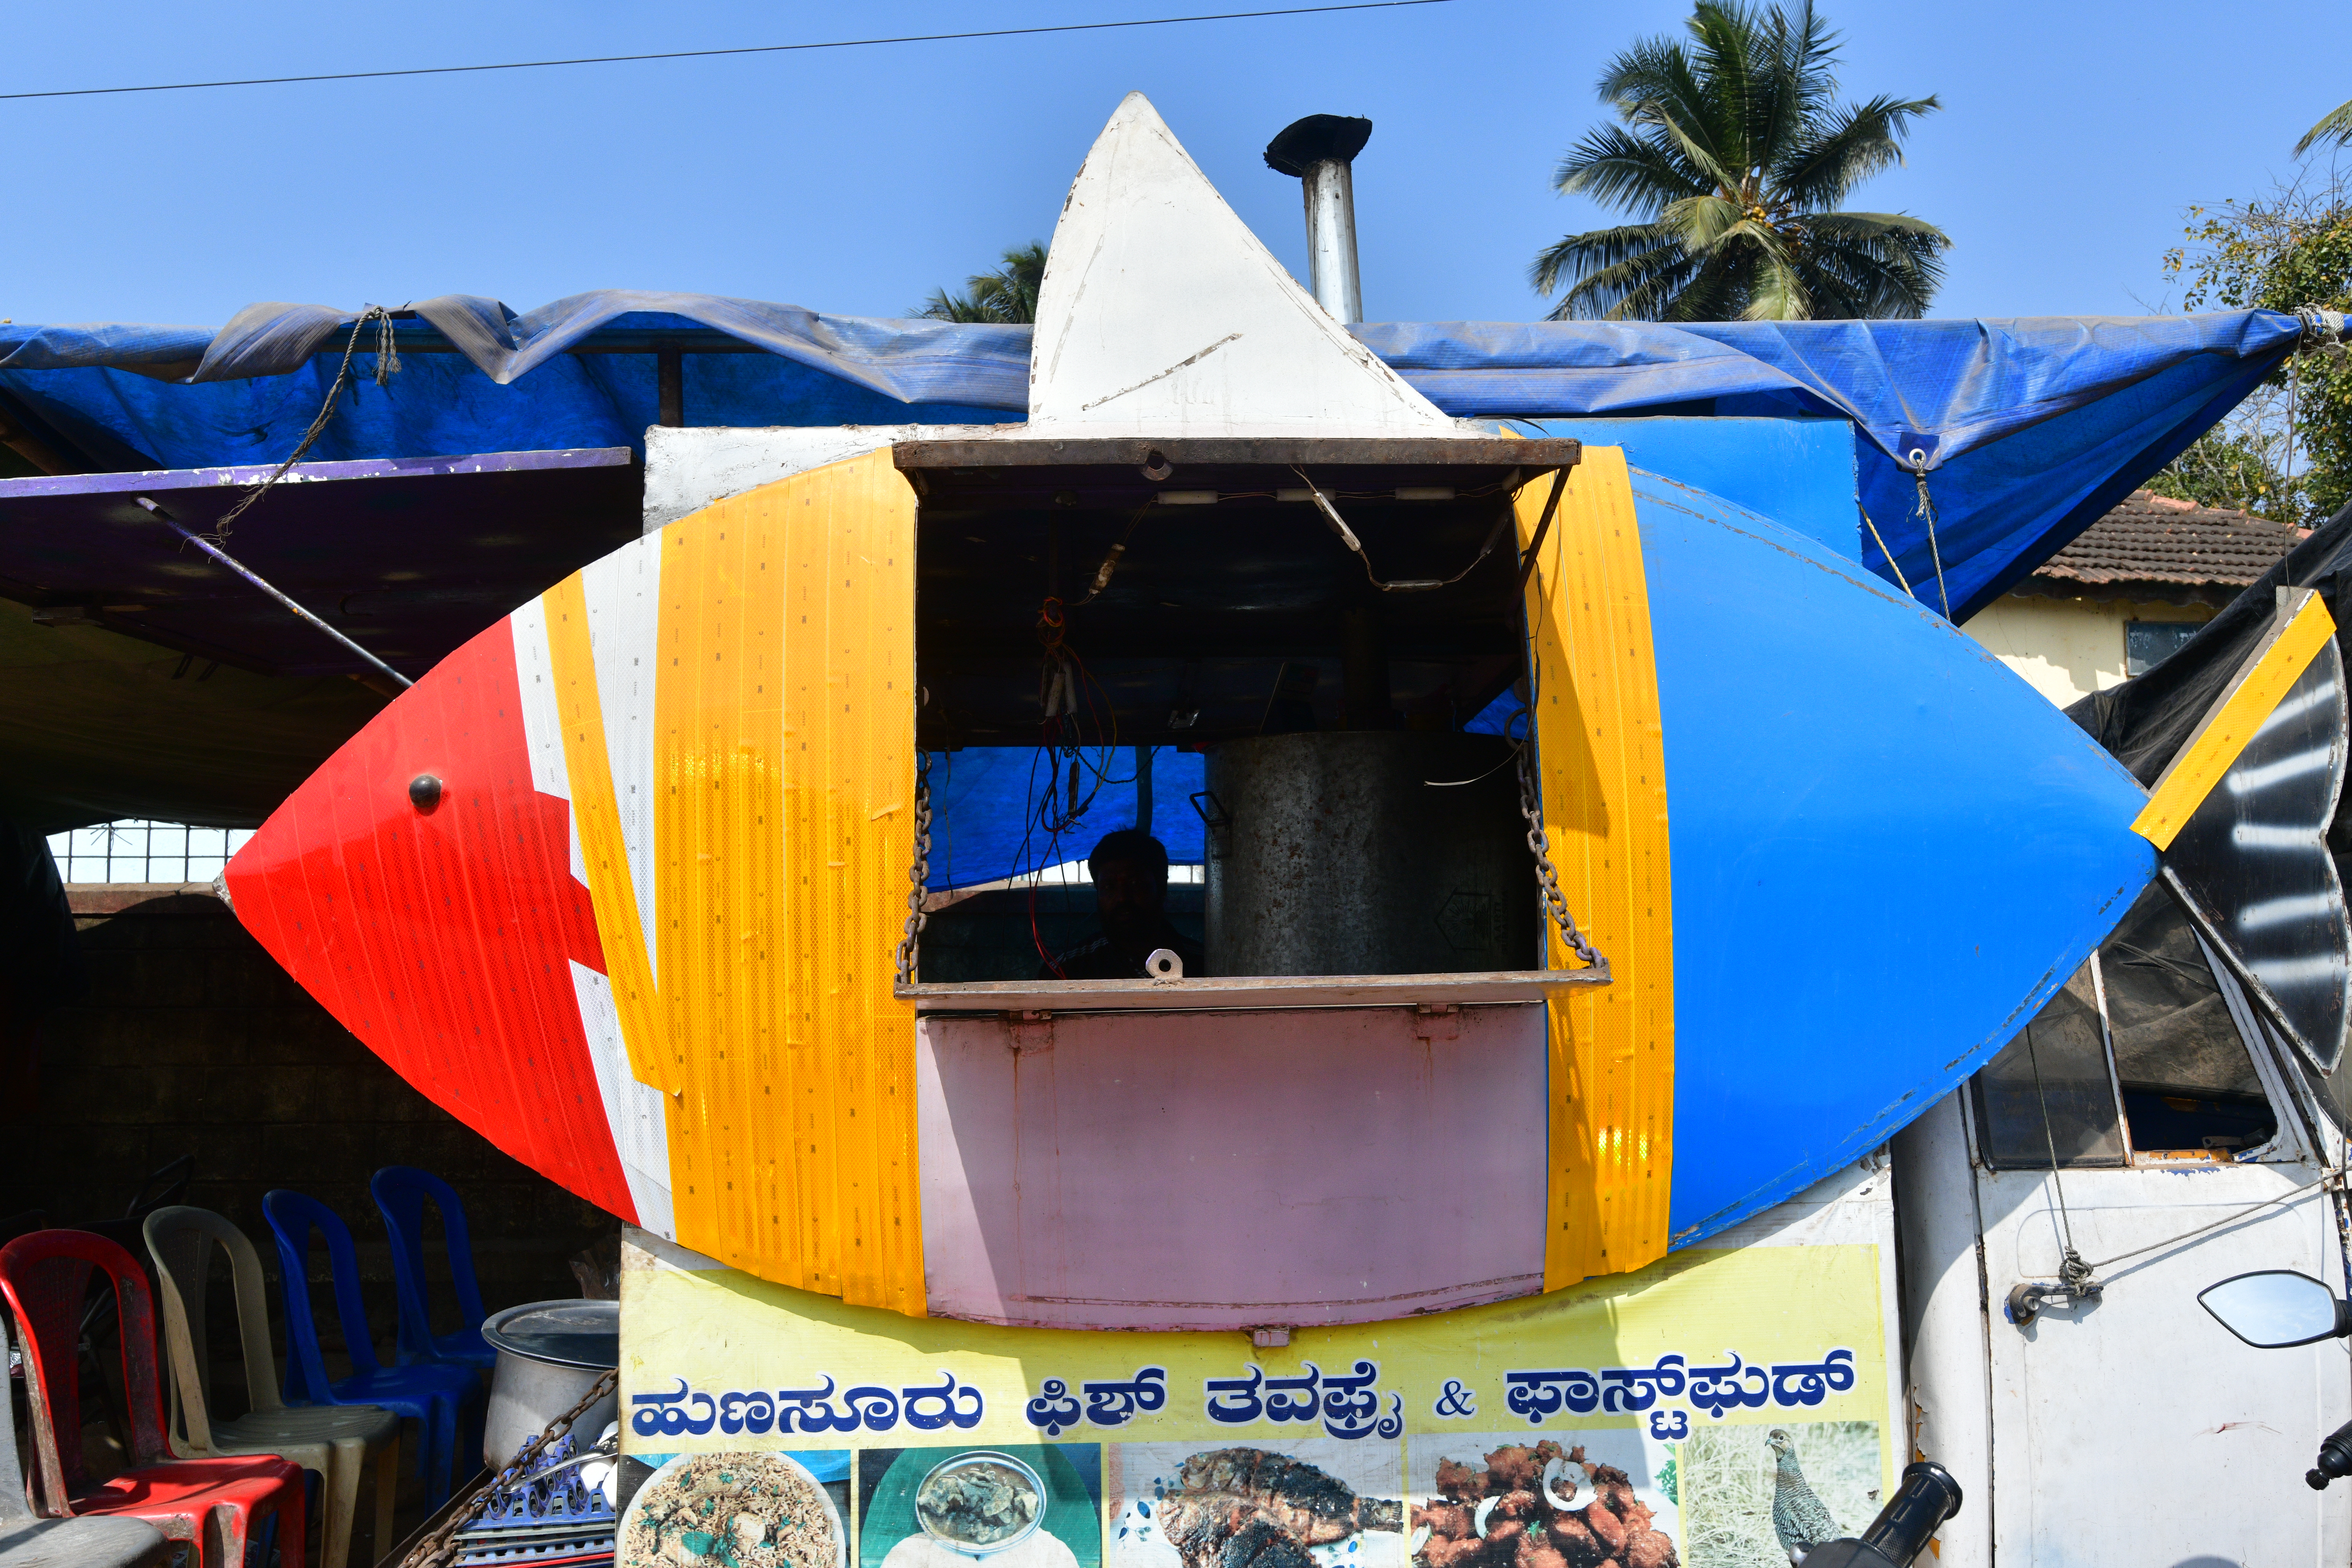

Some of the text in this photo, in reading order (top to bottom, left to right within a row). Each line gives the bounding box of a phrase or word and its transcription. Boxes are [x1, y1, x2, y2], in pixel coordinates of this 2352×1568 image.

[1552, 696, 1557, 705] 3M
[845, 704, 849, 713] 3M
[1596, 728, 1601, 737] 3M
[580, 733, 585, 742] 3M
[802, 743, 806, 751] 3M
[1641, 776, 1645, 784] 3M
[631, 785, 635, 793] 3M
[715, 781, 719, 789] 3M
[672, 786, 676, 795] 3M
[758, 816, 762, 824] 3M
[846, 837, 850, 846] 3M
[602, 861, 608, 869] 3M
[803, 876, 808, 885] 3M
[716, 915, 721, 923] 3M
[673, 920, 678, 929] 3M
[760, 951, 765, 959] 3M
[888, 950, 892, 958] 3M
[593, 976, 599, 985] 3M
[631, 991, 637, 1000] 3M
[805, 1012, 809, 1021] 3M
[679, 1055, 683, 1064] 3M
[720, 1051, 724, 1059] 3M
[765, 1086, 770, 1095] 3M
[890, 1086, 895, 1095] 3M
[1566, 1095, 1571, 1103] 3M
[850, 1108, 855, 1117] 3M
[811, 1144, 816, 1154] 3M
[1647, 1170, 1652, 1179] 3M
[689, 1186, 694, 1194] 3M
[727, 1182, 732, 1190] 3M
[773, 1216, 778, 1224] 3M
[895, 1217, 900, 1226] 3M
[856, 1238, 861, 1247] 3M
[632, 1372, 983, 1437] ಹುಣಸೂರು
[1026, 1367, 1165, 1436] ಫಿಶ್
[1207, 1361, 1402, 1440] ತವಫ್ರೈ
[1436, 1381, 1475, 1416] &
